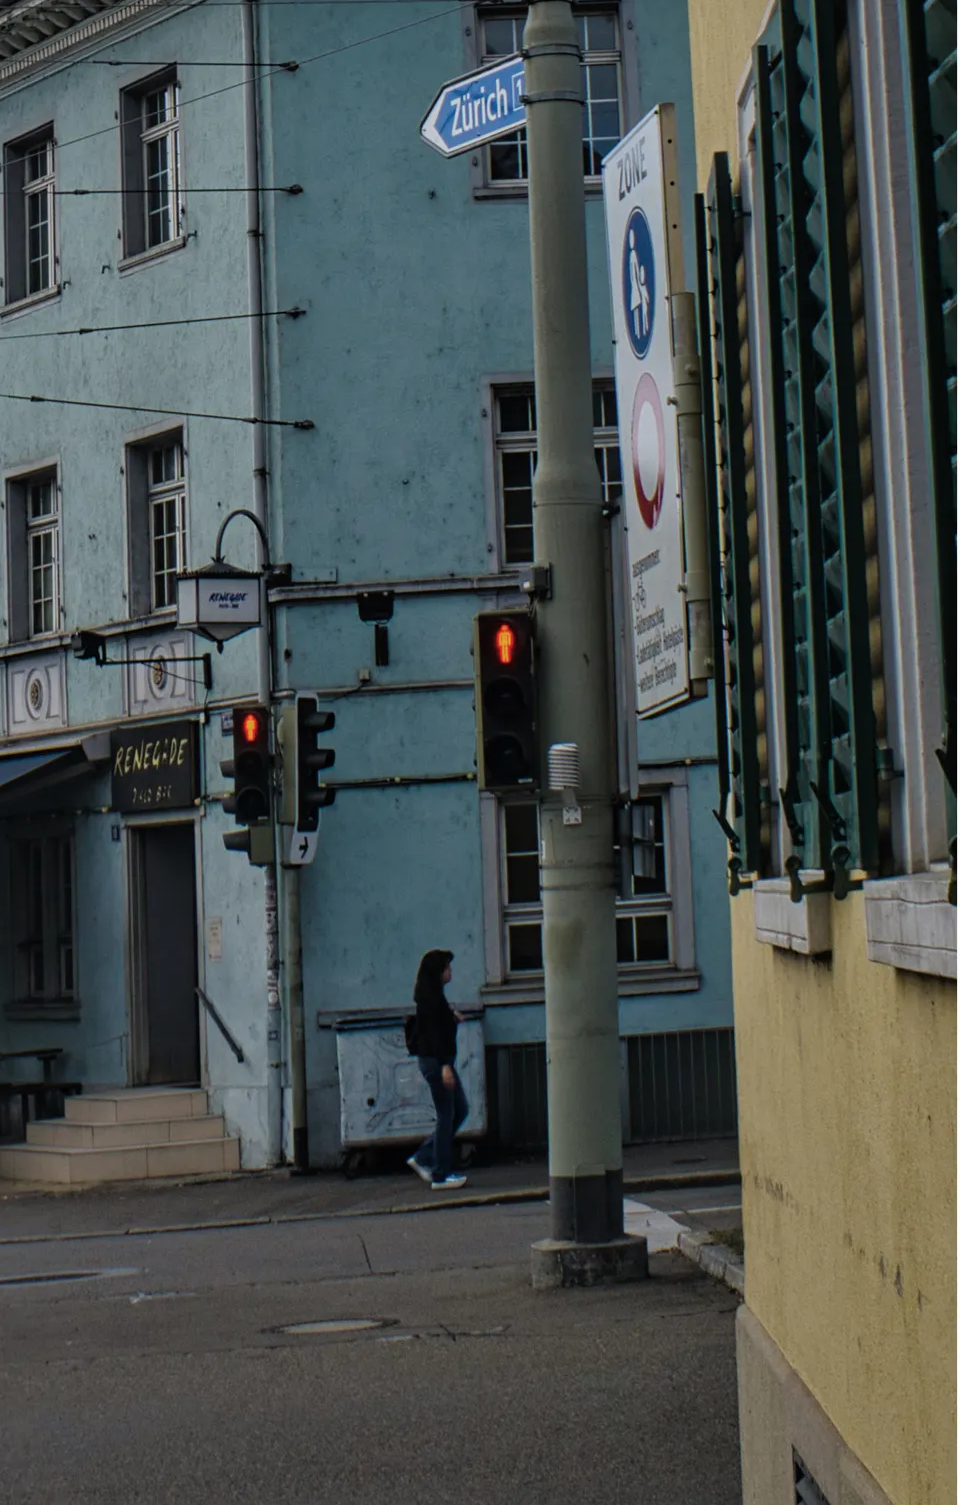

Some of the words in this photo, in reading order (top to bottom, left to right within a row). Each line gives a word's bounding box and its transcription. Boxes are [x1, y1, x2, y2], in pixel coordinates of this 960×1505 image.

[450, 78, 508, 136] Zürich
[617, 136, 647, 201] ZONE
[114, 737, 188, 777] RENEGADE
